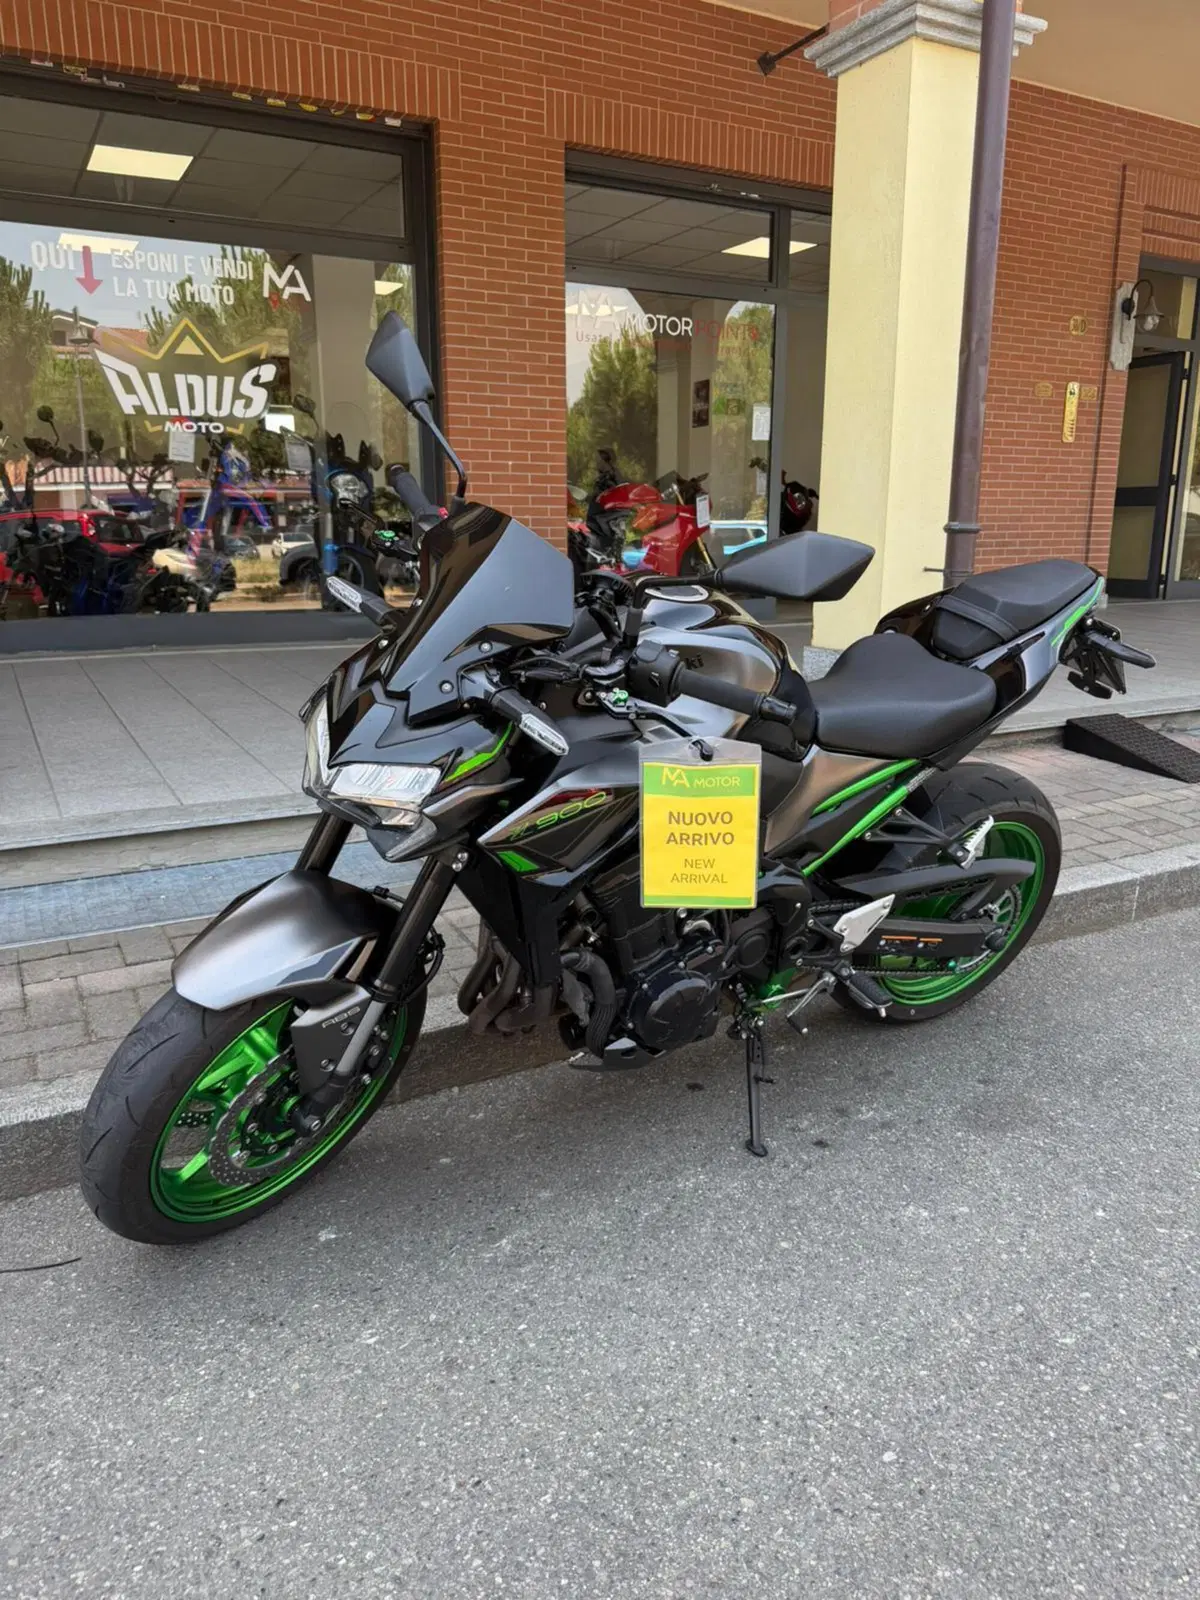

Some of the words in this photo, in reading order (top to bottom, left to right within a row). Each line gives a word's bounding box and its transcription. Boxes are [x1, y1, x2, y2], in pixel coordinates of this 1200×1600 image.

[30, 240, 75, 271] QUI
[111, 248, 178, 273] ESPONI
[184, 255, 196, 275] E
[200, 256, 254, 281] VENDI
[113, 277, 139, 298] LA
[145, 279, 180, 301] TUA
[185, 283, 235, 306] MOTO
[95, 348, 277, 419] ALDUS
[164, 421, 225, 434] MOTO
[693, 775, 741, 789] MOTOR
[667, 811, 734, 826] NUOVO
[665, 832, 735, 846] ARRIVO
[683, 858, 716, 869] NEW
[670, 873, 728, 884] ARRIVAL
[321, 1006, 361, 1028] ABS
